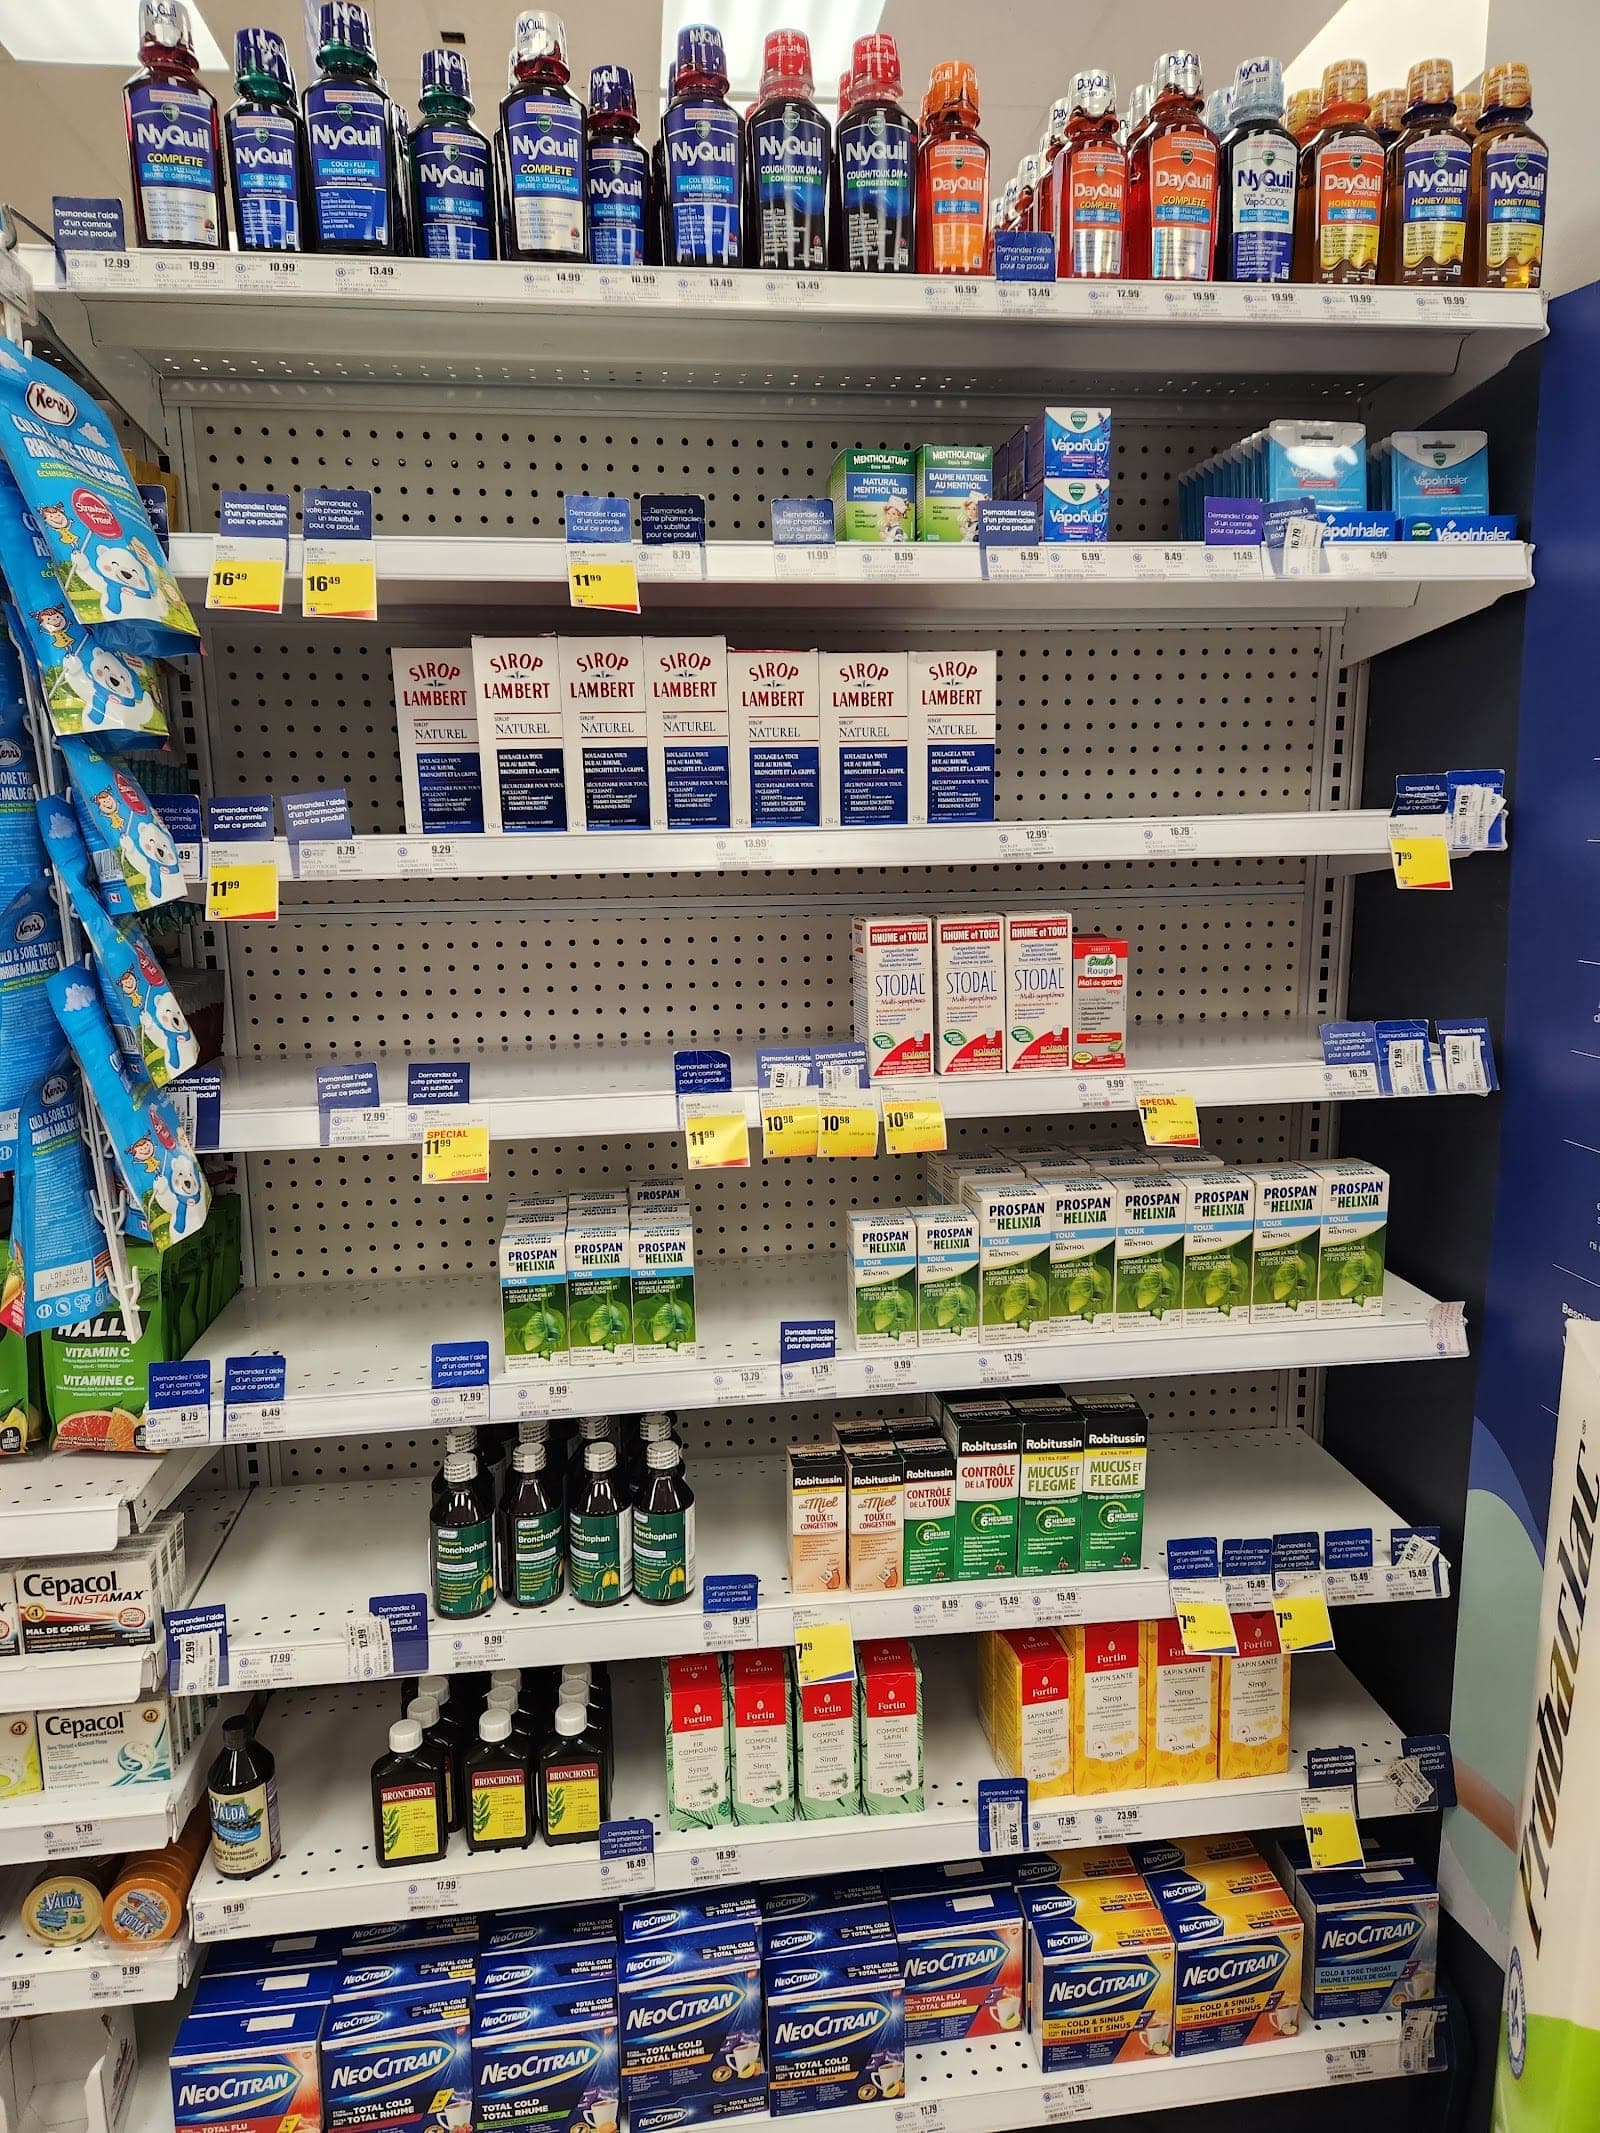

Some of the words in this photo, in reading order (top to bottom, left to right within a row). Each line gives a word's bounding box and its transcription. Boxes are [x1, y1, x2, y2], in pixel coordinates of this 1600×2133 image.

[137, 123, 209, 153] NyQuil
[312, 125, 381, 149] NyQuil
[672, 142, 735, 166] NyQuil
[761, 137, 821, 160] NyQuil
[846, 140, 908, 164] NyQuil
[148, 152, 203, 166] COMPLETE
[521, 165, 573, 176] COMPLETE
[421, 165, 484, 190] NyQuil
[1156, 171, 1212, 191] DayQuil
[1324, 174, 1381, 192] DayQuil
[1408, 169, 1467, 189] NyQuil
[932, 177, 982, 192] DayQuil
[1074, 183, 1122, 199] DayQuil
[1328, 199, 1375, 208] HONEY/MIEL
[1412, 197, 1462, 205] HONEY/MIEL
[55, 209, 96, 218] Demandez
[99, 211, 119, 219] l'aide
[63, 218, 80, 226] d'un
[59, 228, 76, 236] pour
[90, 229, 117, 238] produit
[269, 262, 295, 272] 10.99
[369, 266, 394, 276] 13.49
[556, 272, 581, 282] 14.99
[709, 278, 732, 288] 13.49
[954, 285, 976, 294] 10.99
[1052, 434, 1106, 452] VapoRub
[956, 474, 988, 482] NATUREL
[948, 482, 981, 490] MENTHOL
[325, 507, 364, 516] pharmacien
[1050, 506, 1102, 524] VapoRub
[663, 515, 701, 524] pharmacien
[664, 523, 690, 531] substitut
[1436, 521, 1510, 542] VapoInhaler
[646, 531, 661, 539] pour
[1020, 552, 1039, 561] 6.99
[1082, 552, 1100, 561] 6.99
[1232, 552, 1252, 560] 11.49
[490, 652, 543, 673] SIROP
[660, 652, 711, 672] SIROP
[749, 662, 798, 682] SIROP
[839, 662, 889, 682] SIROP
[484, 682, 550, 699] LAMBERT
[654, 681, 717, 698] LAMBERT
[404, 690, 467, 706] LAMBERT
[833, 691, 894, 707] LAMBERT
[922, 690, 982, 705] LAMBERT
[496, 723, 549, 734] NATUREL
[664, 721, 716, 733] NATUREL
[749, 727, 800, 738] NATUREL
[839, 726, 889, 737] NATUREL
[928, 724, 977, 735] NATUREL
[1026, 830, 1047, 839] 12.99
[1170, 827, 1190, 836] 16.79
[336, 846, 355, 855] 8.79
[432, 845, 452, 854] 9.29
[872, 933, 898, 943] RHUME
[900, 933, 907, 942] et
[908, 931, 927, 941] TOUX
[943, 931, 969, 942] RHUME
[971, 930, 978, 940] et
[980, 929, 998, 939] TOUX
[1015, 969, 1064, 991] STODAL
[1079, 978, 1091, 986] Mal
[1101, 978, 1123, 988] gorge
[1349, 1070, 1368, 1078] 16.79
[44, 1082, 67, 1099] Kerr's
[362, 1112, 385, 1122] 12.99
[1264, 1185, 1317, 1199] PROSPAN
[1330, 1181, 1383, 1195] PROSPAN
[1056, 1197, 1111, 1210] PROSPAN
[1125, 1193, 1180, 1207] PROSPAN
[990, 1202, 1045, 1216] PROSPAN
[638, 1241, 686, 1253] PROSPAN
[870, 1242, 906, 1253] HELIXIA
[582, 1253, 620, 1264] HELIXIA
[645, 1252, 683, 1263] HELIXIA
[516, 1261, 555, 1272] HELIXIA
[58, 1318, 129, 1337] HALL
[894, 1360, 911, 1369] 9.99
[64, 1376, 123, 1385] VITAMINE
[125, 1376, 134, 1385] C
[549, 1385, 567, 1395] 9.99
[1026, 1438, 1082, 1451] Robitussin
[1089, 1433, 1145, 1446] Robitussin
[961, 1440, 1018, 1453] Robitussin
[961, 1463, 1016, 1478] CONTRÔLE
[1028, 1466, 1068, 1478] MUCUS
[1070, 1466, 1079, 1475] ET
[795, 1474, 842, 1486] Robitussin
[1028, 1478, 1076, 1492] FLEGME
[801, 1521, 838, 1530] CONGESTION
[438, 1540, 487, 1554] Bronchophan
[1350, 1572, 1368, 1582] 15.49
[1246, 1580, 1266, 1588] 15.49
[68, 1590, 144, 1606] INSTAMAX
[46, 1626, 58, 1634] DE
[60, 1624, 90, 1633] GORGE
[270, 1653, 290, 1664] 17.99
[1097, 1652, 1126, 1664] Fortin
[1248, 1679, 1267, 1689] Sirop
[1102, 1694, 1121, 1704] Sirop
[814, 1704, 842, 1714] Fortin
[878, 1701, 906, 1710] Fortin
[684, 1715, 712, 1724] Fortin
[746, 1712, 774, 1720] Fortin
[550, 1769, 596, 1781] BRONCHOSYL
[474, 1775, 522, 1787] BRONCHOSYL
[382, 1788, 432, 1801] BRONCHOSYL
[1117, 1810, 1137, 1820] 23.99
[75, 1824, 93, 1833] 5.79
[716, 1850, 736, 1860] 18.99
[436, 1881, 456, 1891] 17.99
[46, 1894, 81, 1910] VALDA
[223, 1903, 244, 1913] 19.99
[1365, 1966, 1391, 1974] THROAT
[940, 1999, 967, 2008] GRIPPE
[1067, 2019, 1088, 2028] COLD
[1099, 2015, 1124, 2024] SINUS
[647, 2044, 677, 2055] TOTAL
[679, 2040, 702, 2050] COLD
[1350, 2050, 1366, 2059] 11.79
[353, 2103, 384, 2115] TOTAL
[386, 2098, 411, 2109] COLD
[482, 2110, 512, 2121] TOTAL
[514, 2105, 548, 2117] RHUME
